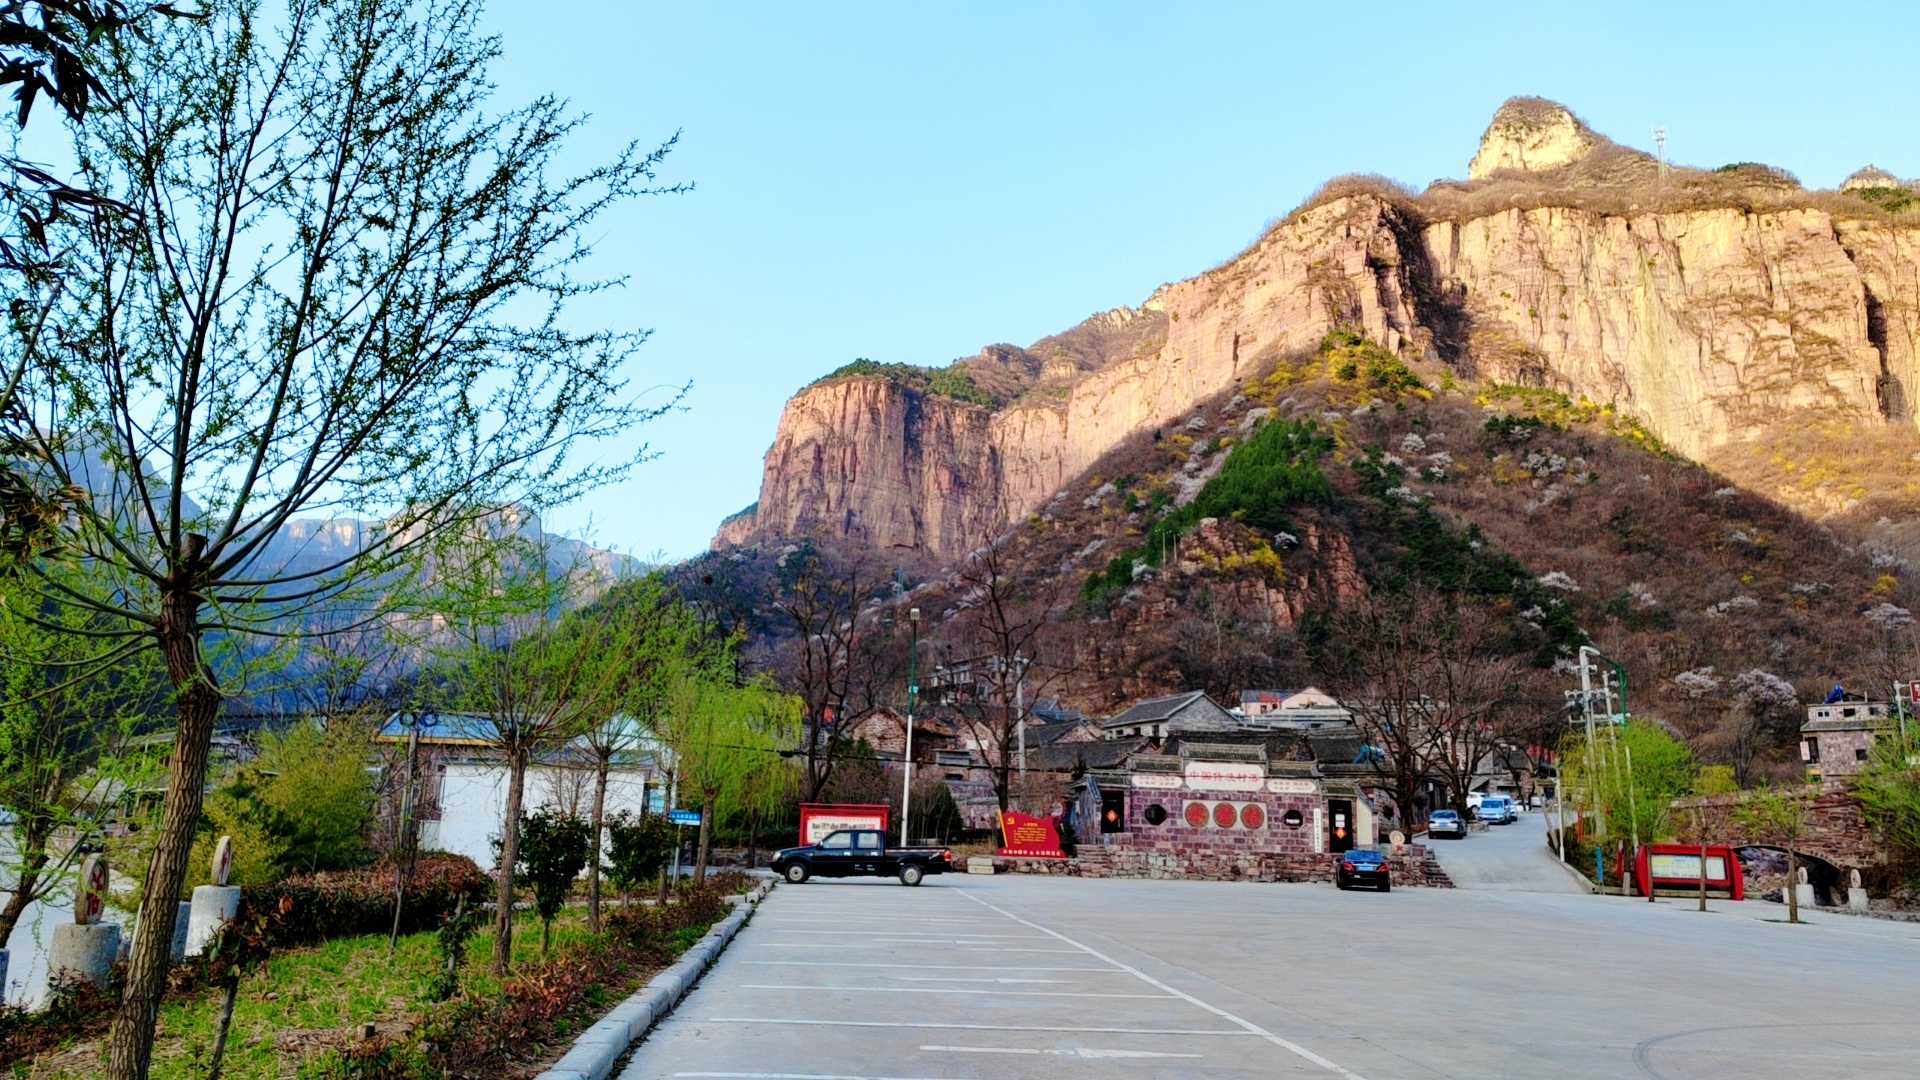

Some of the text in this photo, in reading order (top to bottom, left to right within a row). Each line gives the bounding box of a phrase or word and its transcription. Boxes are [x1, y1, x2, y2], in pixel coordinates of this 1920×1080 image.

[1190, 770, 1259, 783] 中国传统村落
